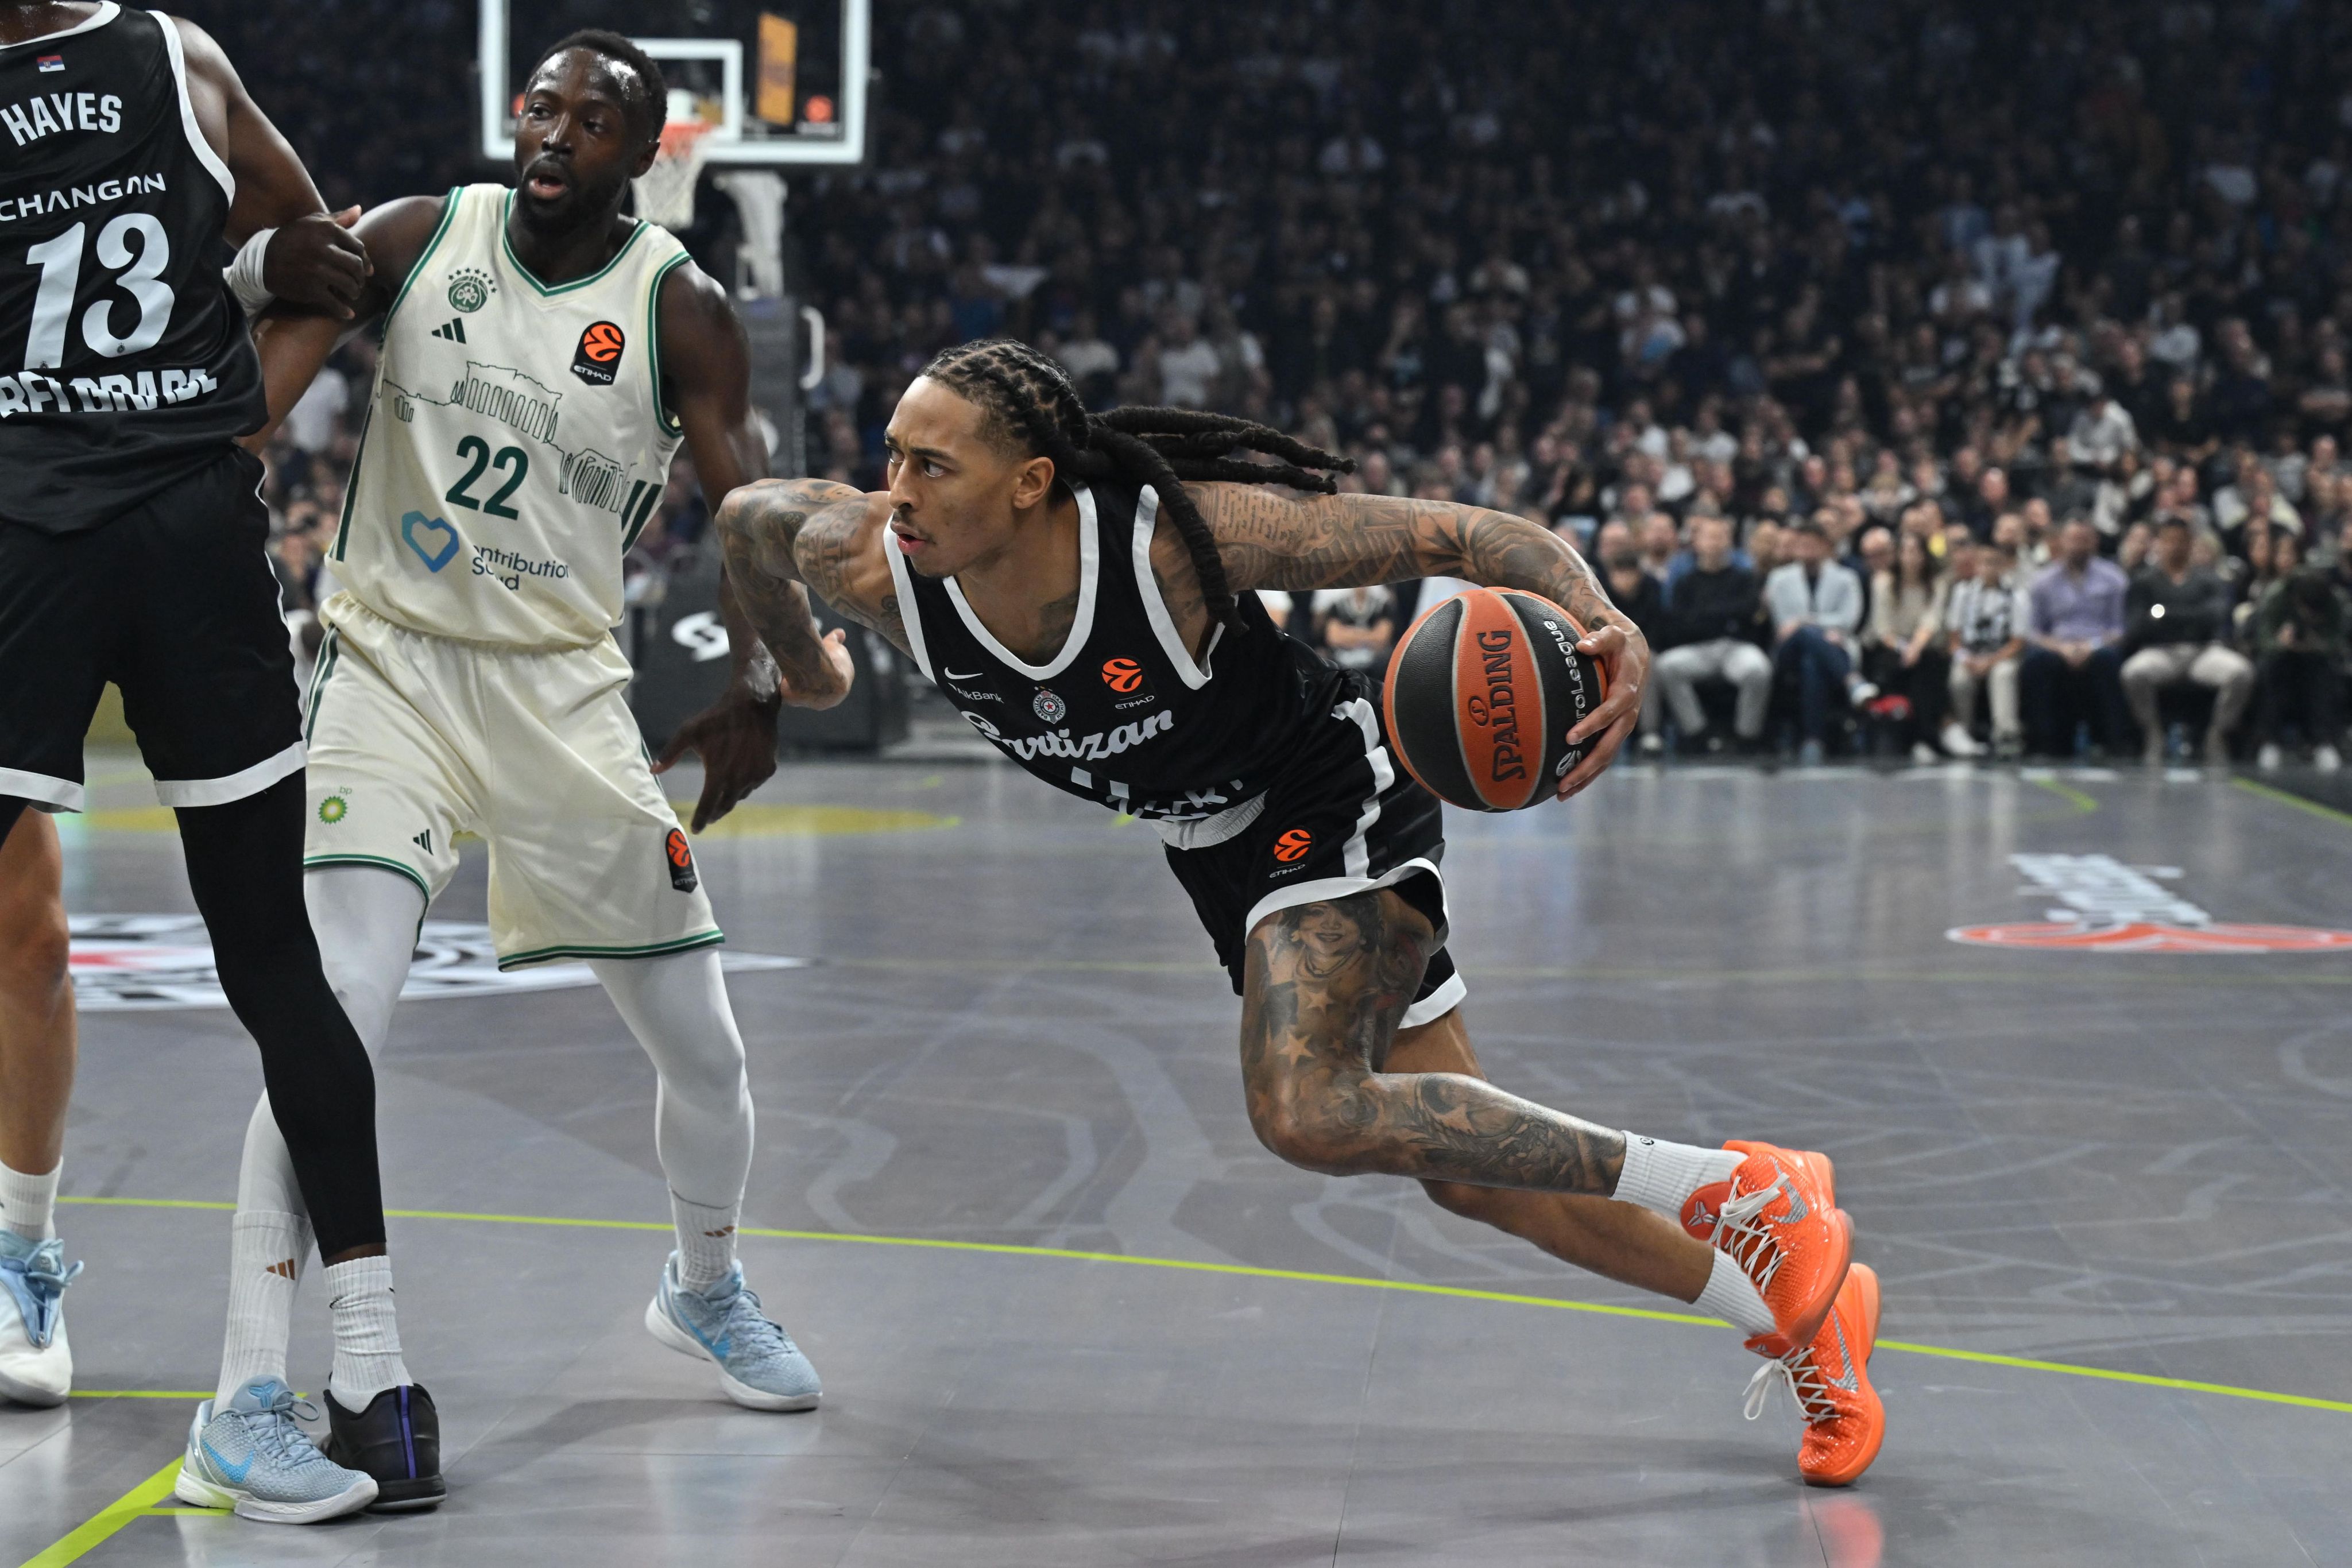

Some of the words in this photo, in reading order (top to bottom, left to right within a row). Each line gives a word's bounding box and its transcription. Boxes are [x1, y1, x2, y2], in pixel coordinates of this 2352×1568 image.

[0, 92, 122, 146] HAYES
[0, 173, 166, 221] CHANGAN
[24, 212, 175, 370] 13
[574, 365, 612, 381] ETIHAD
[445, 435, 528, 520] 22
[1115, 695, 1155, 709] ETIHAD
[1476, 630, 1526, 782] SPALDING
[1269, 864, 1306, 878] ETIHAD
